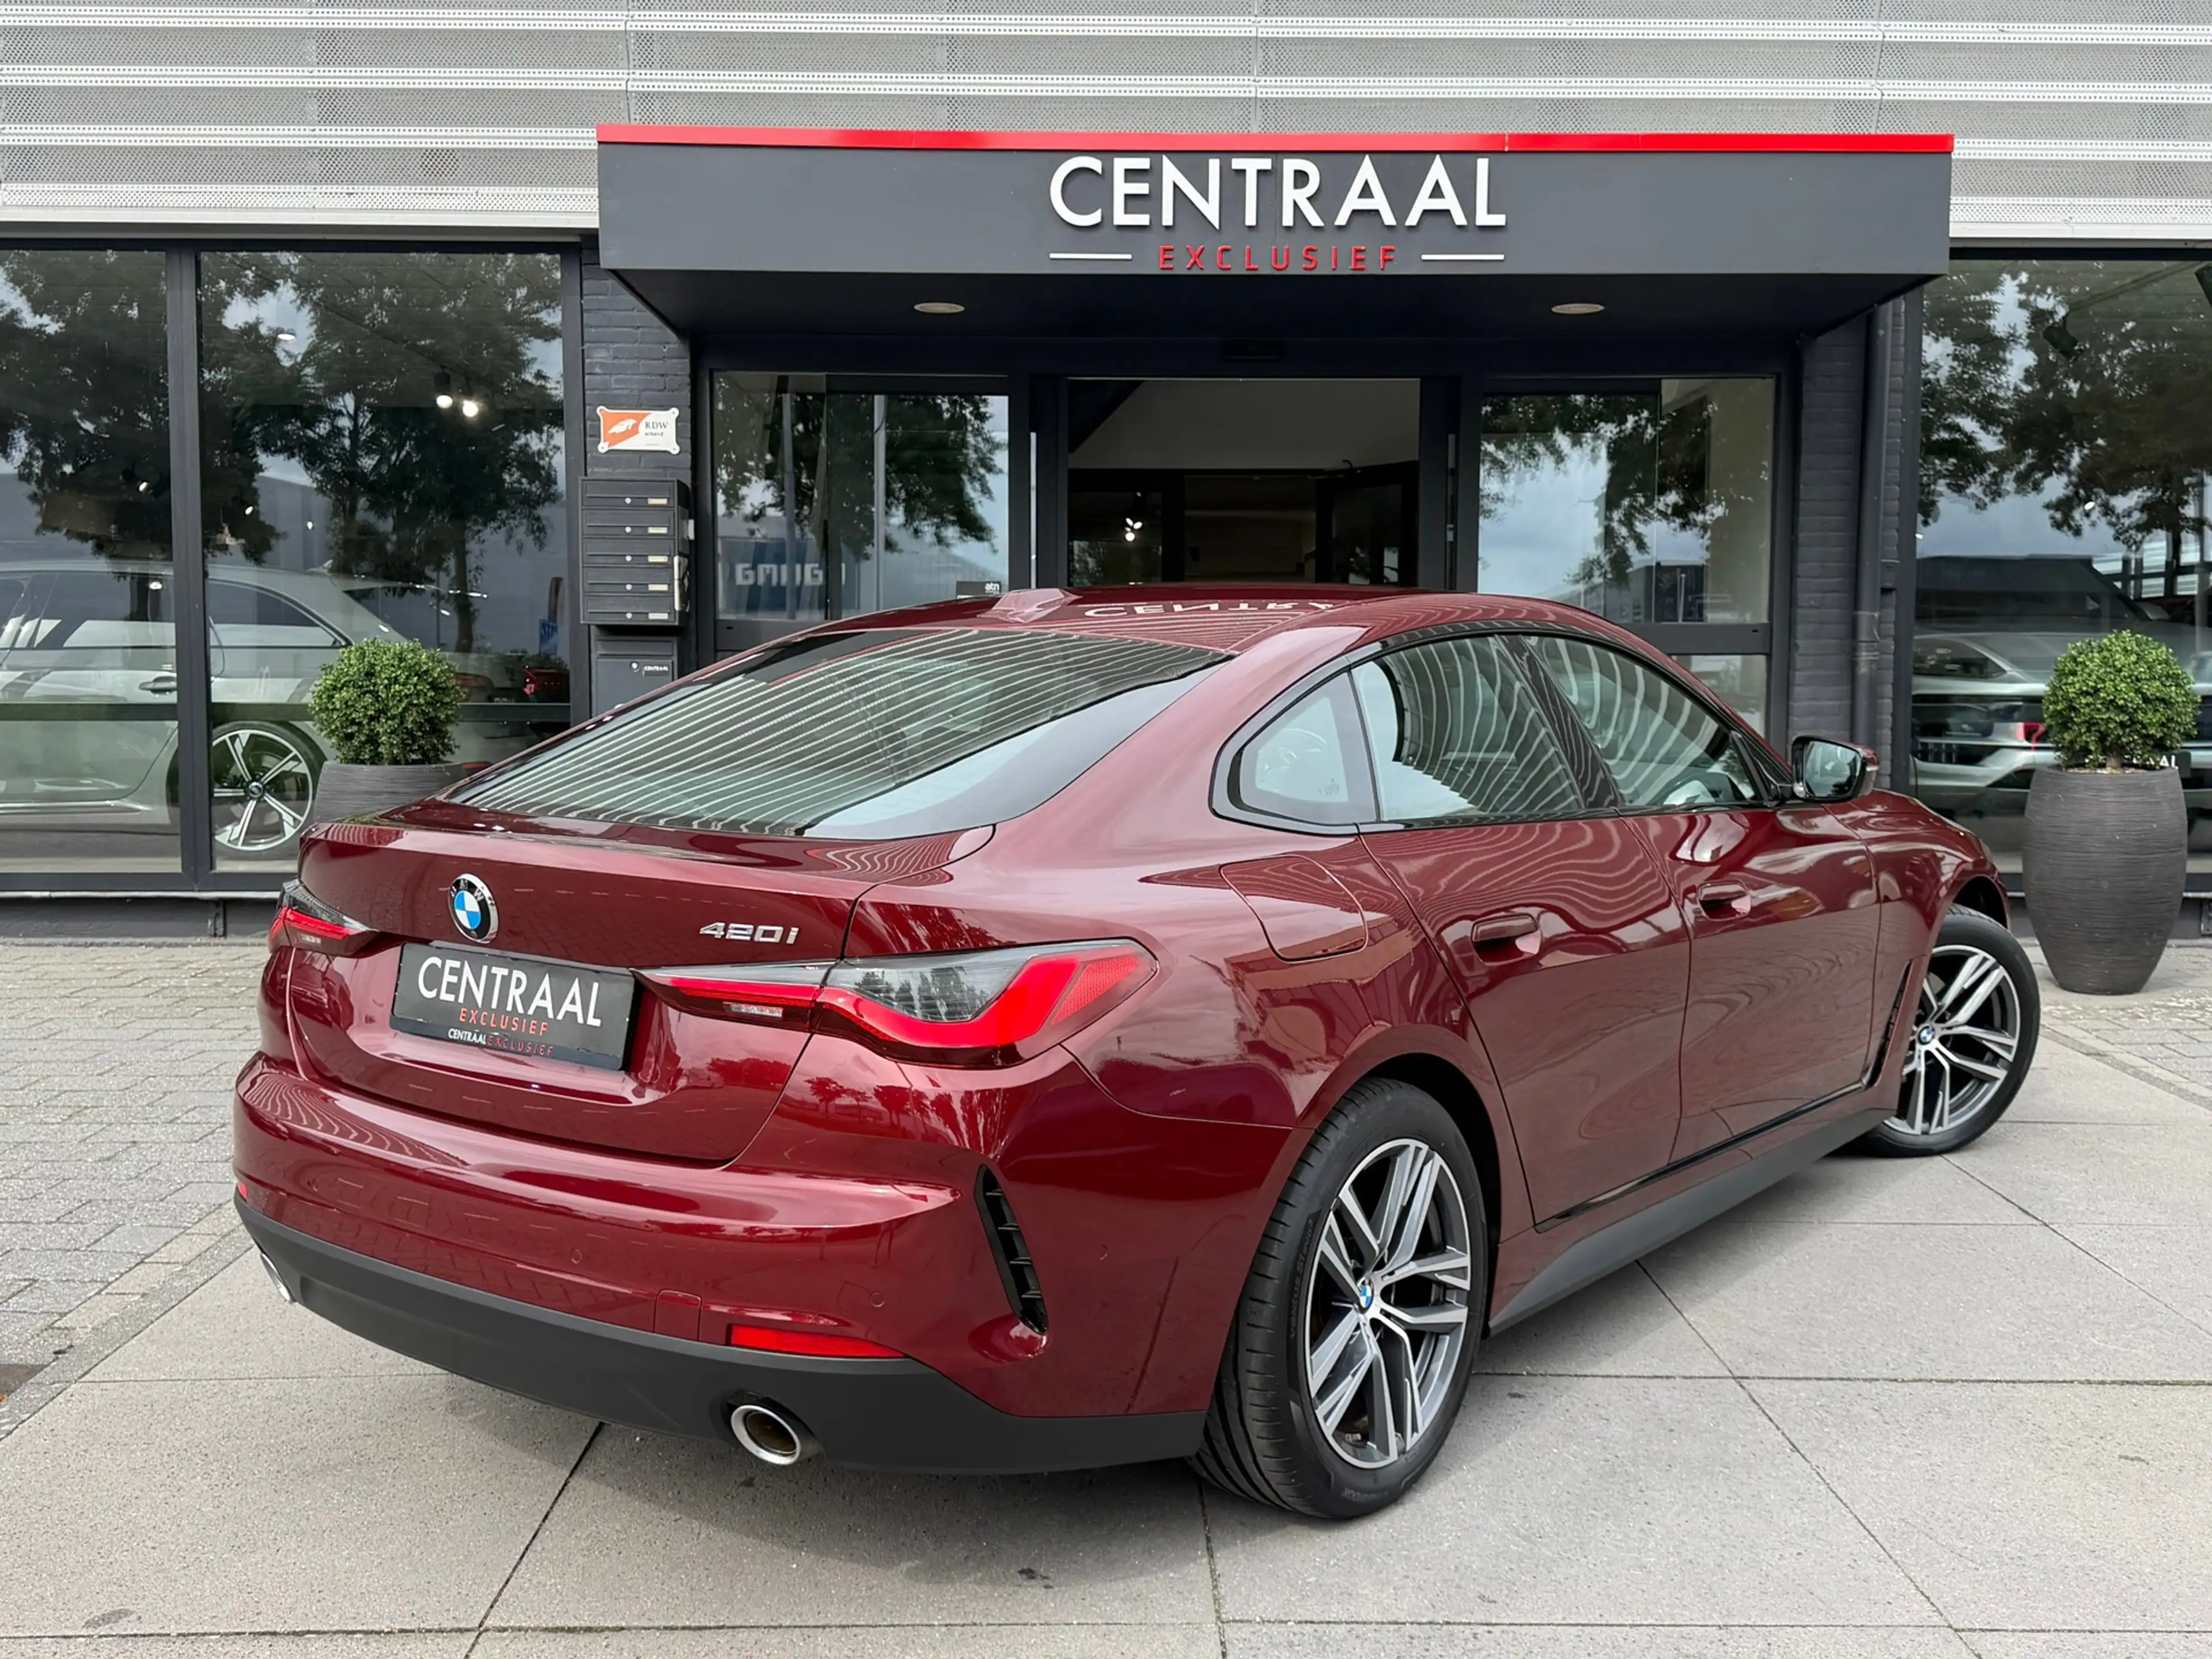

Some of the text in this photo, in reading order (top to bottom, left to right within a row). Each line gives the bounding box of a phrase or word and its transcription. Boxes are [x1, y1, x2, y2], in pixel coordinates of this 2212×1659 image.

[1050, 155, 1506, 229] CENTRAAL
[1159, 245, 1396, 271] EXCLUSIEF
[645, 421, 668, 429] RDW
[699, 922, 800, 945] 420i
[417, 956, 602, 1027] CENTRAAL
[459, 1007, 549, 1037] EXCLUSIEF
[448, 1028, 554, 1056] CENTRAAL EXCLUSIEF
